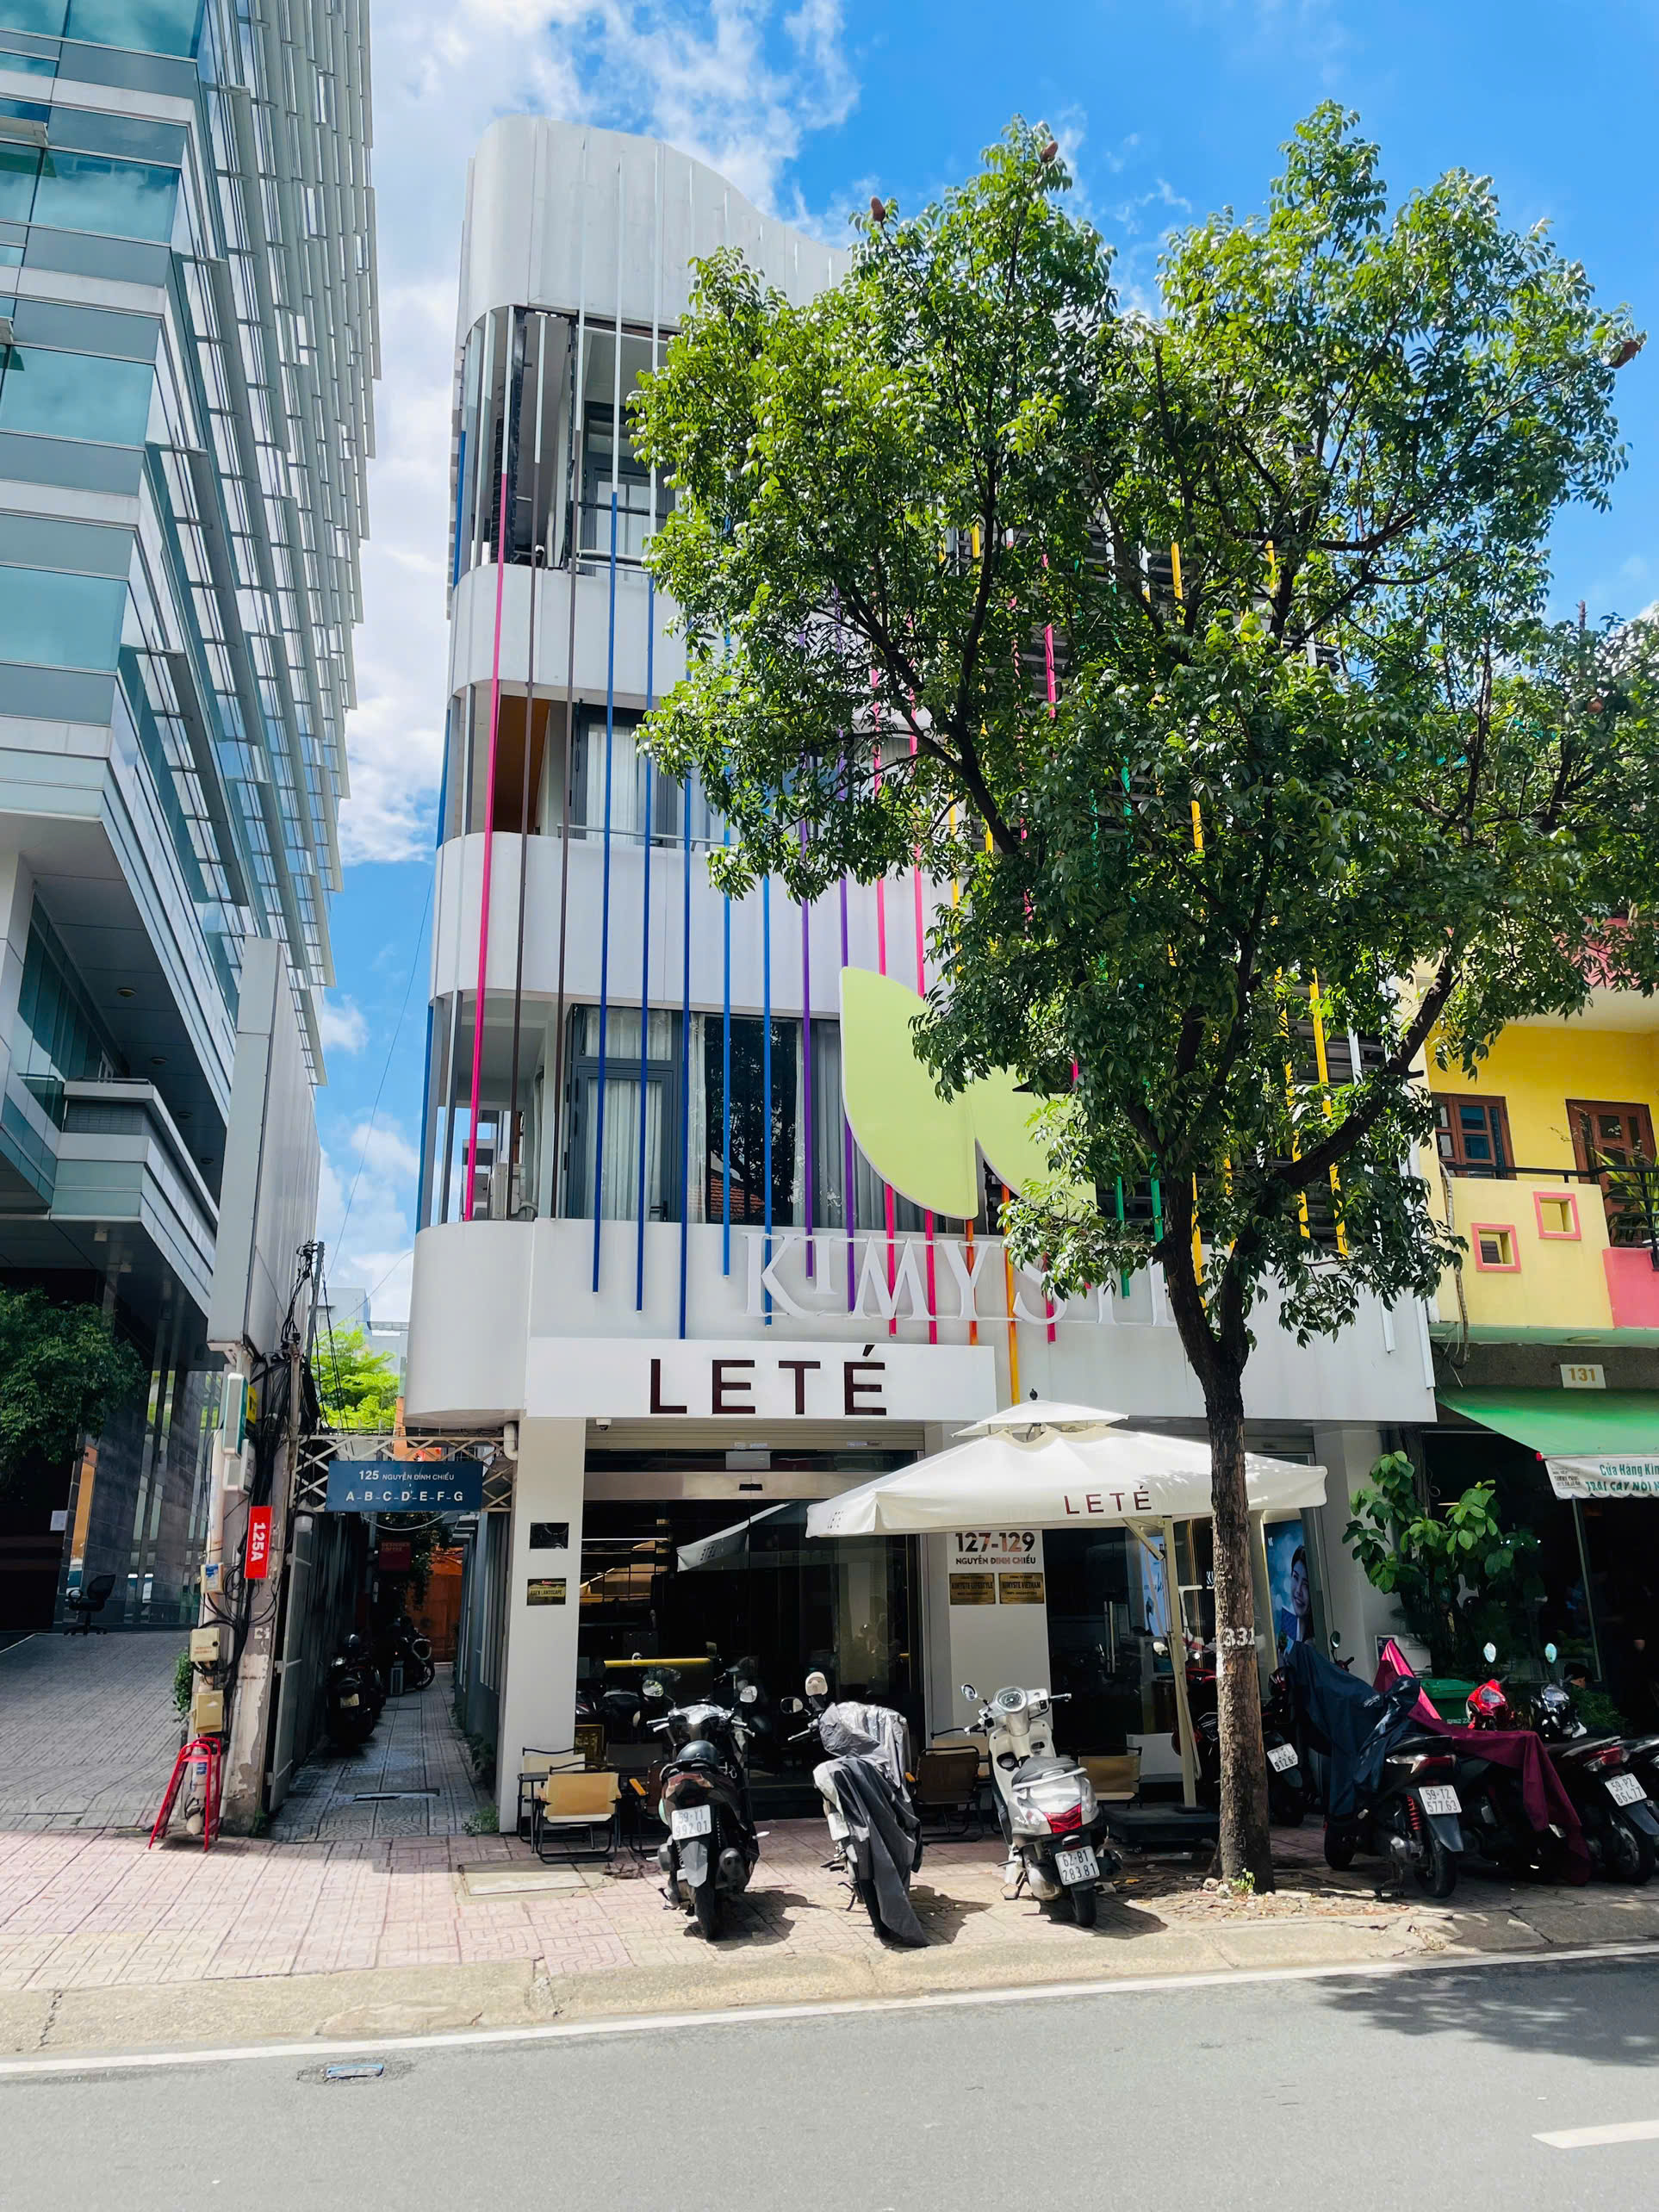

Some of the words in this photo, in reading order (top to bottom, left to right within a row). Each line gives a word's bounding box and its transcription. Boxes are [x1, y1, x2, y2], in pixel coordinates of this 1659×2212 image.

[743, 1232, 1177, 1328] KIMYS
[650, 1344, 887, 1415] LETÉ
[1569, 1367, 1596, 1382] 131
[358, 1470, 379, 1481] 125
[1064, 1485, 1152, 1515] LETÉ
[250, 1521, 266, 1563] 125A
[955, 1532, 1035, 1553] 127-129
